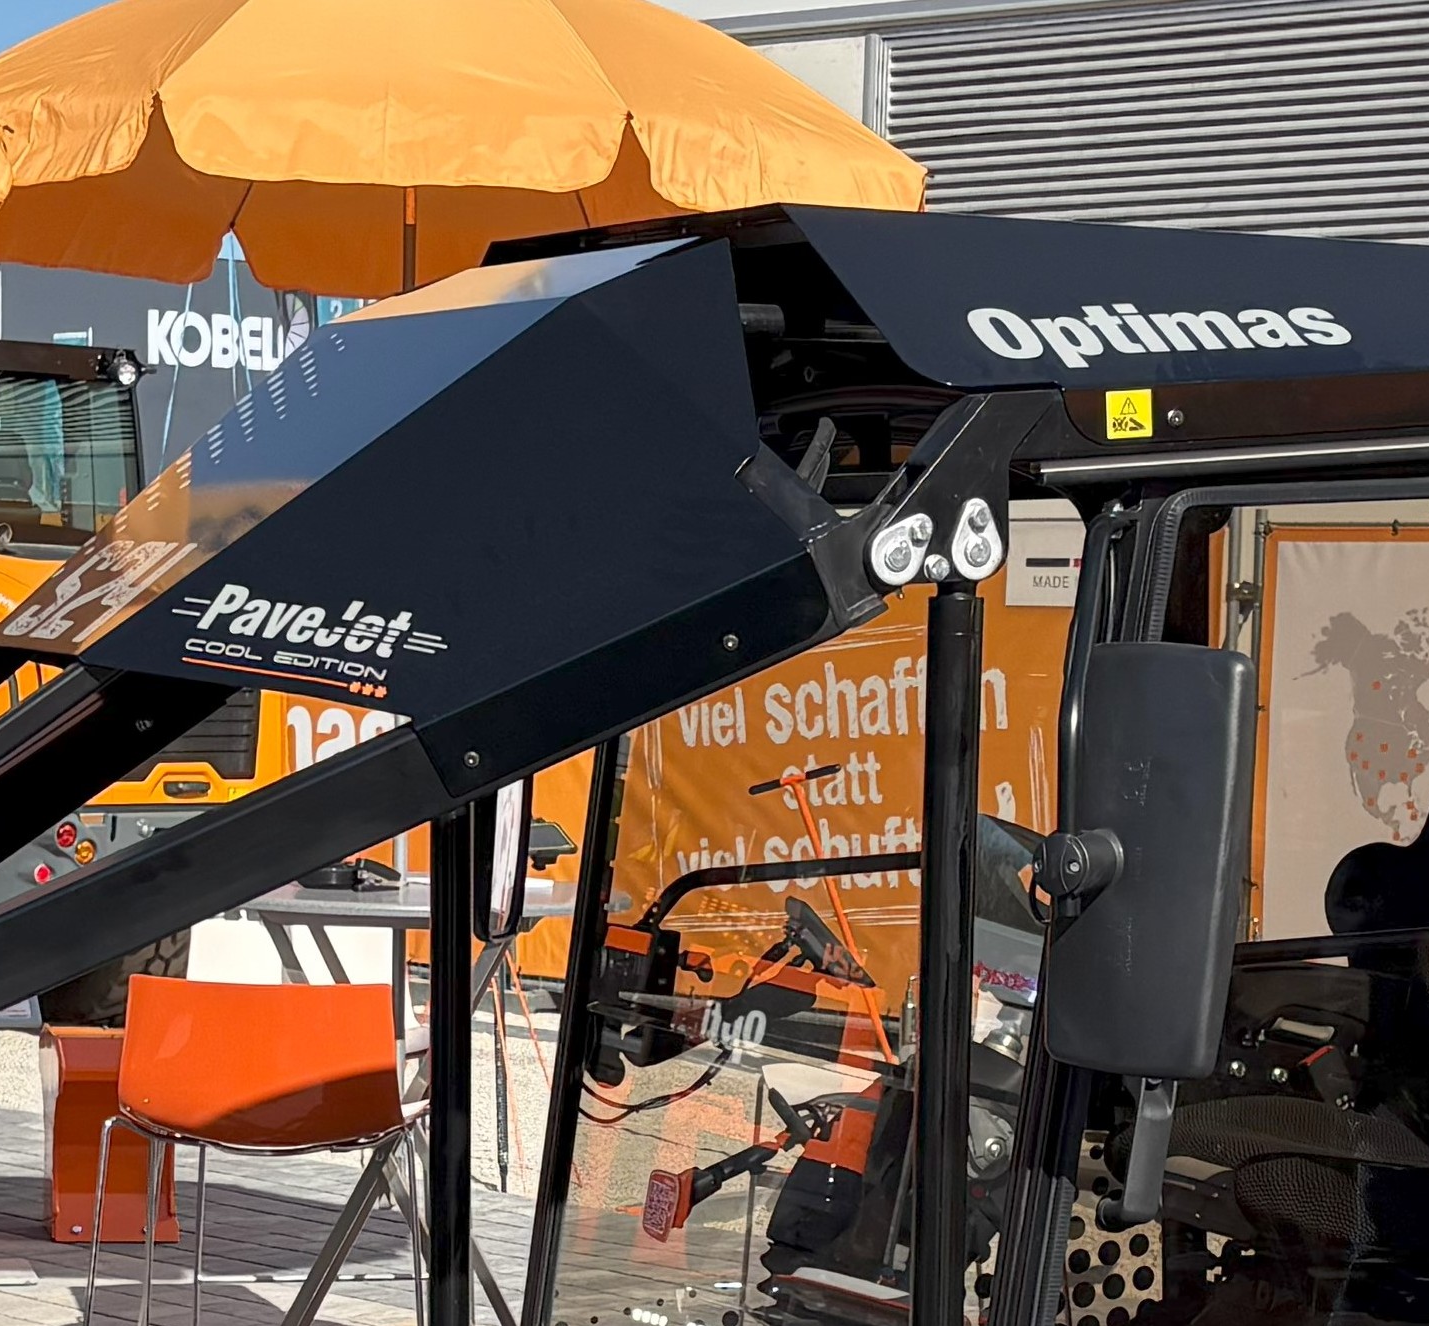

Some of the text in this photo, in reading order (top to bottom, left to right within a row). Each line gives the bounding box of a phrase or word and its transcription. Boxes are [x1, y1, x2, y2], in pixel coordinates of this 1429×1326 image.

[148, 309, 284, 371] KOBEL
[966, 302, 1353, 369] Optimas
[1032, 575, 1070, 589] MADE
[196, 583, 413, 659] PaveJet
[185, 637, 388, 681] COOL EDITION
[677, 687, 747, 747] viel
[782, 751, 883, 811] statt
